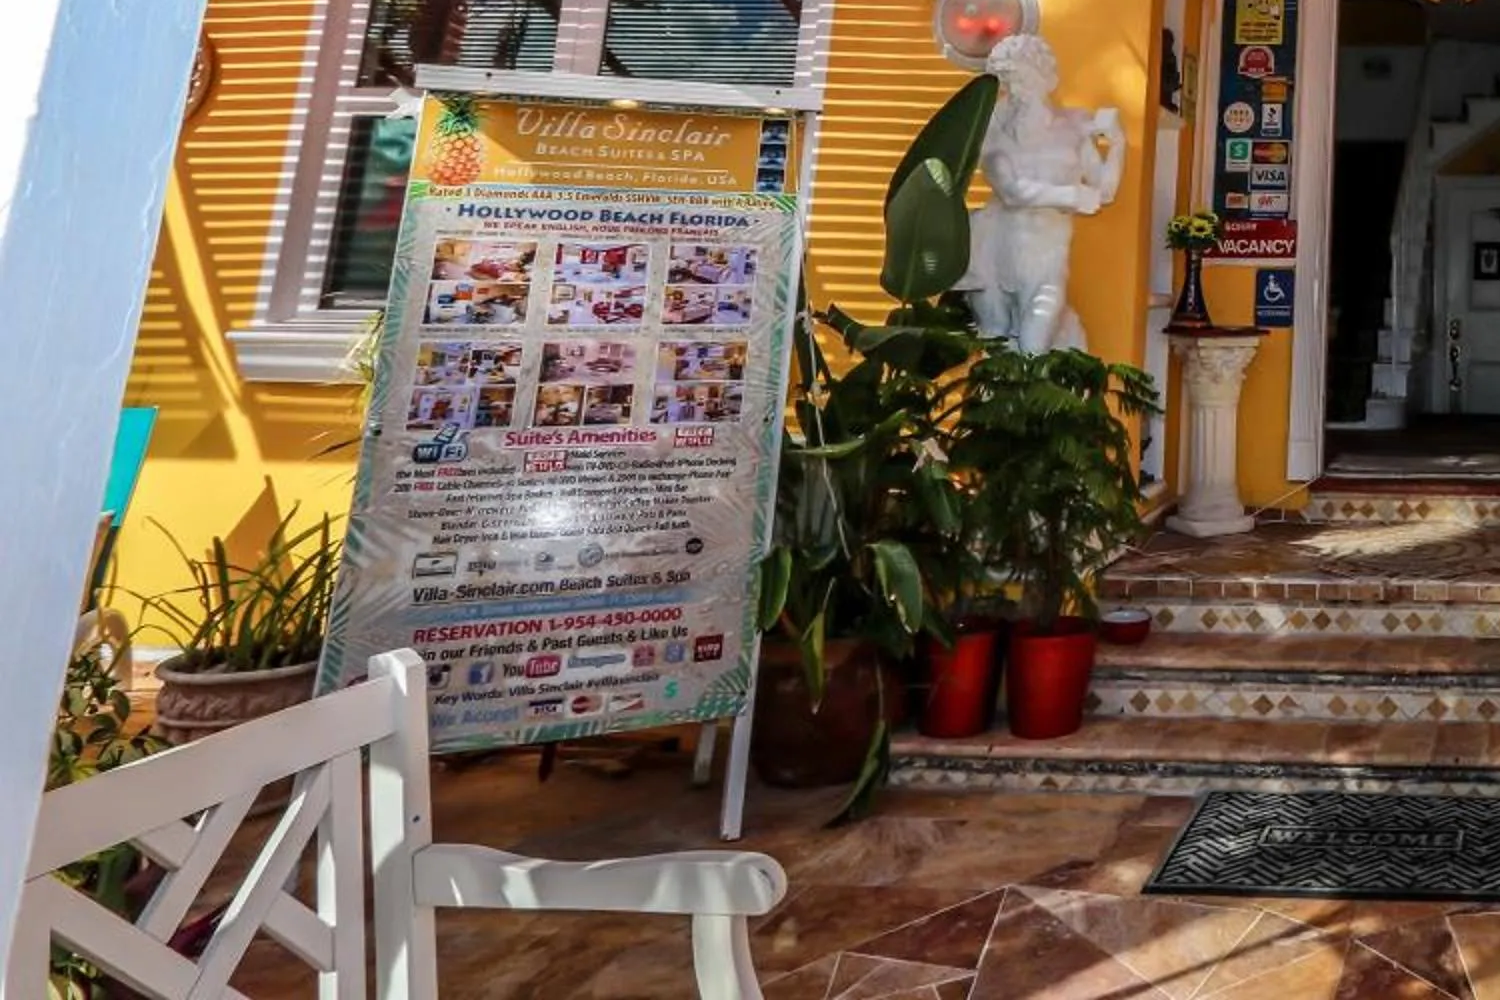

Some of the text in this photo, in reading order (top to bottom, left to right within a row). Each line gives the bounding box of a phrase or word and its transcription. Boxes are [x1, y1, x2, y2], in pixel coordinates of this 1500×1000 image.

[517, 107, 731, 147] Villa Sinclair
[535, 142, 594, 157] BEACH
[671, 149, 705, 162] SPA
[706, 173, 738, 186] USA
[1255, 169, 1285, 181] VISA
[457, 203, 749, 227] HOLLYWOOD BEACH FLORIDA
[1217, 239, 1295, 254] VACANCY
[504, 428, 657, 447] Suite's Amenities
[412, 570, 691, 603] Villa-Sinclair.com Beach Suites & Spa
[412, 619, 543, 644] RESERVATION
[439, 625, 689, 660] our Friends & Past Guests & Like Us
[434, 692, 459, 705] Key
[509, 685, 536, 697] Villa
[538, 679, 587, 694] Sinclair
[1272, 829, 1457, 847] WELCOME
